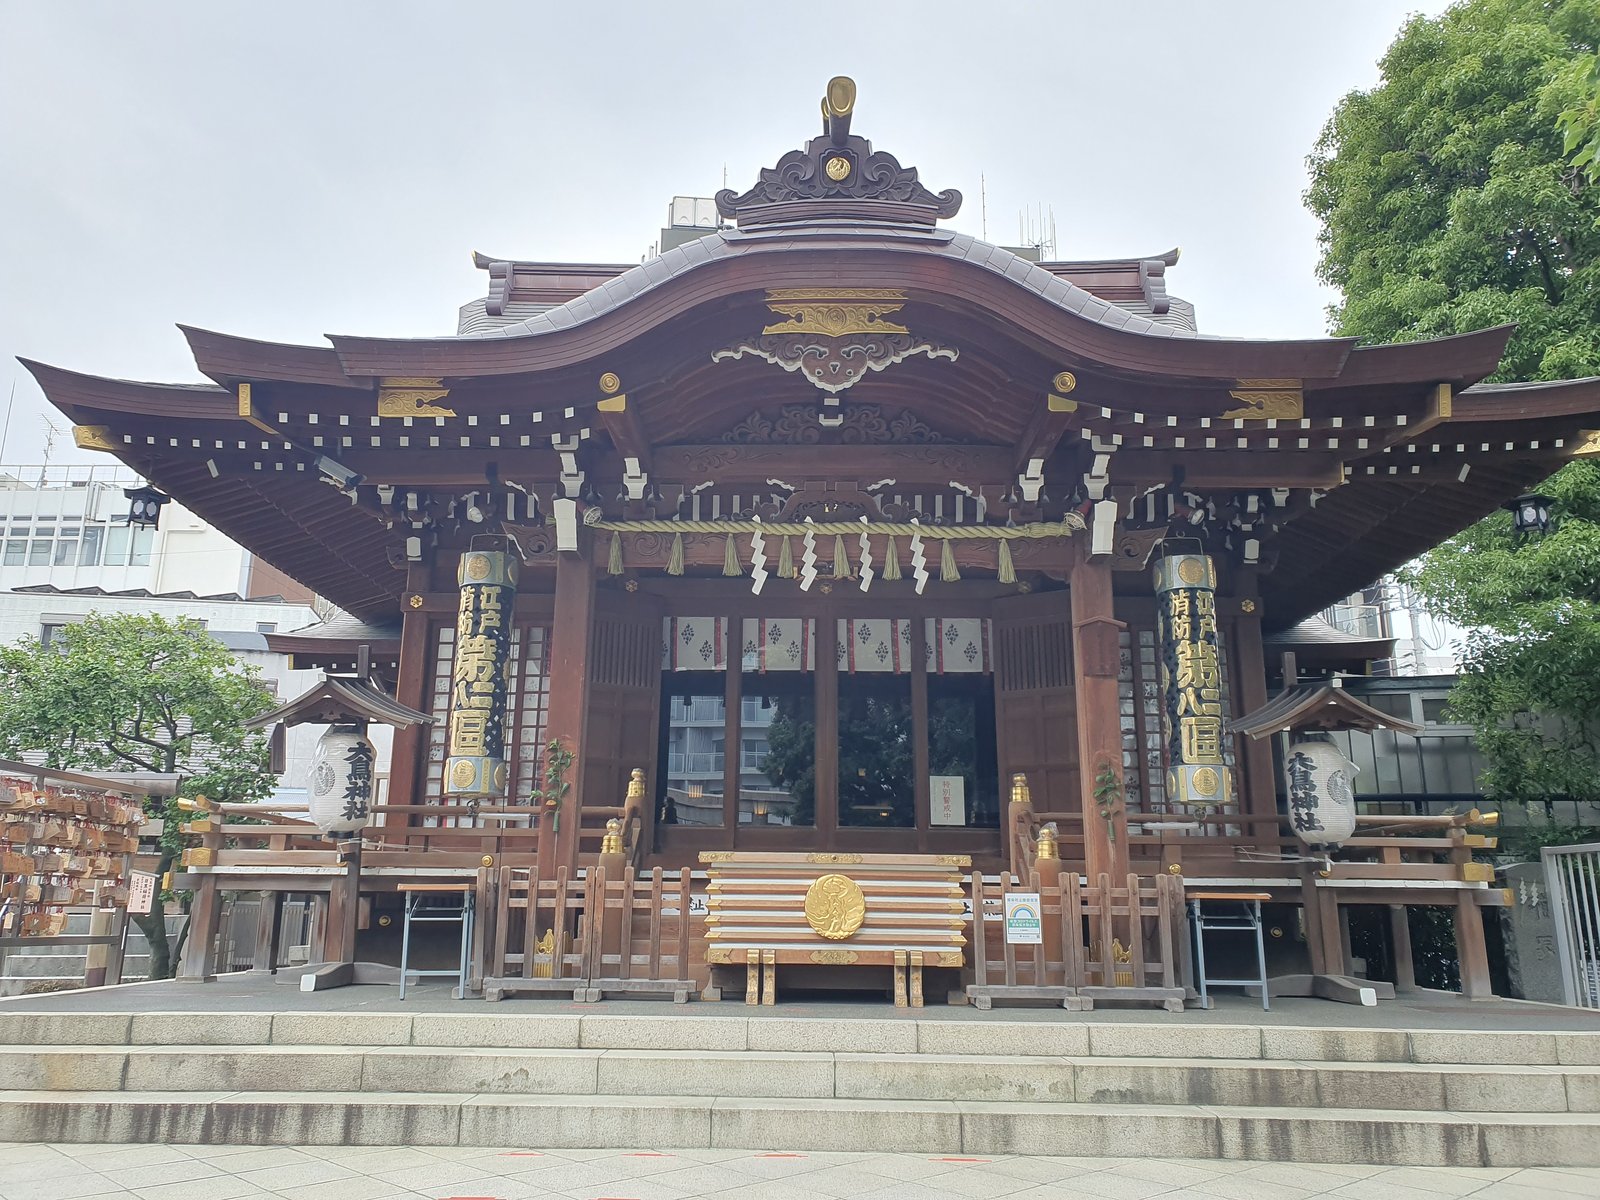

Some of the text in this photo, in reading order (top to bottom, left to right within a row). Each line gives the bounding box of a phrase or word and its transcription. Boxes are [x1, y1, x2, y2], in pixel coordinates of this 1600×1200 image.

[340, 741, 374, 822] 大鳥神社
[1287, 751, 1326, 833] 大鳥神社
